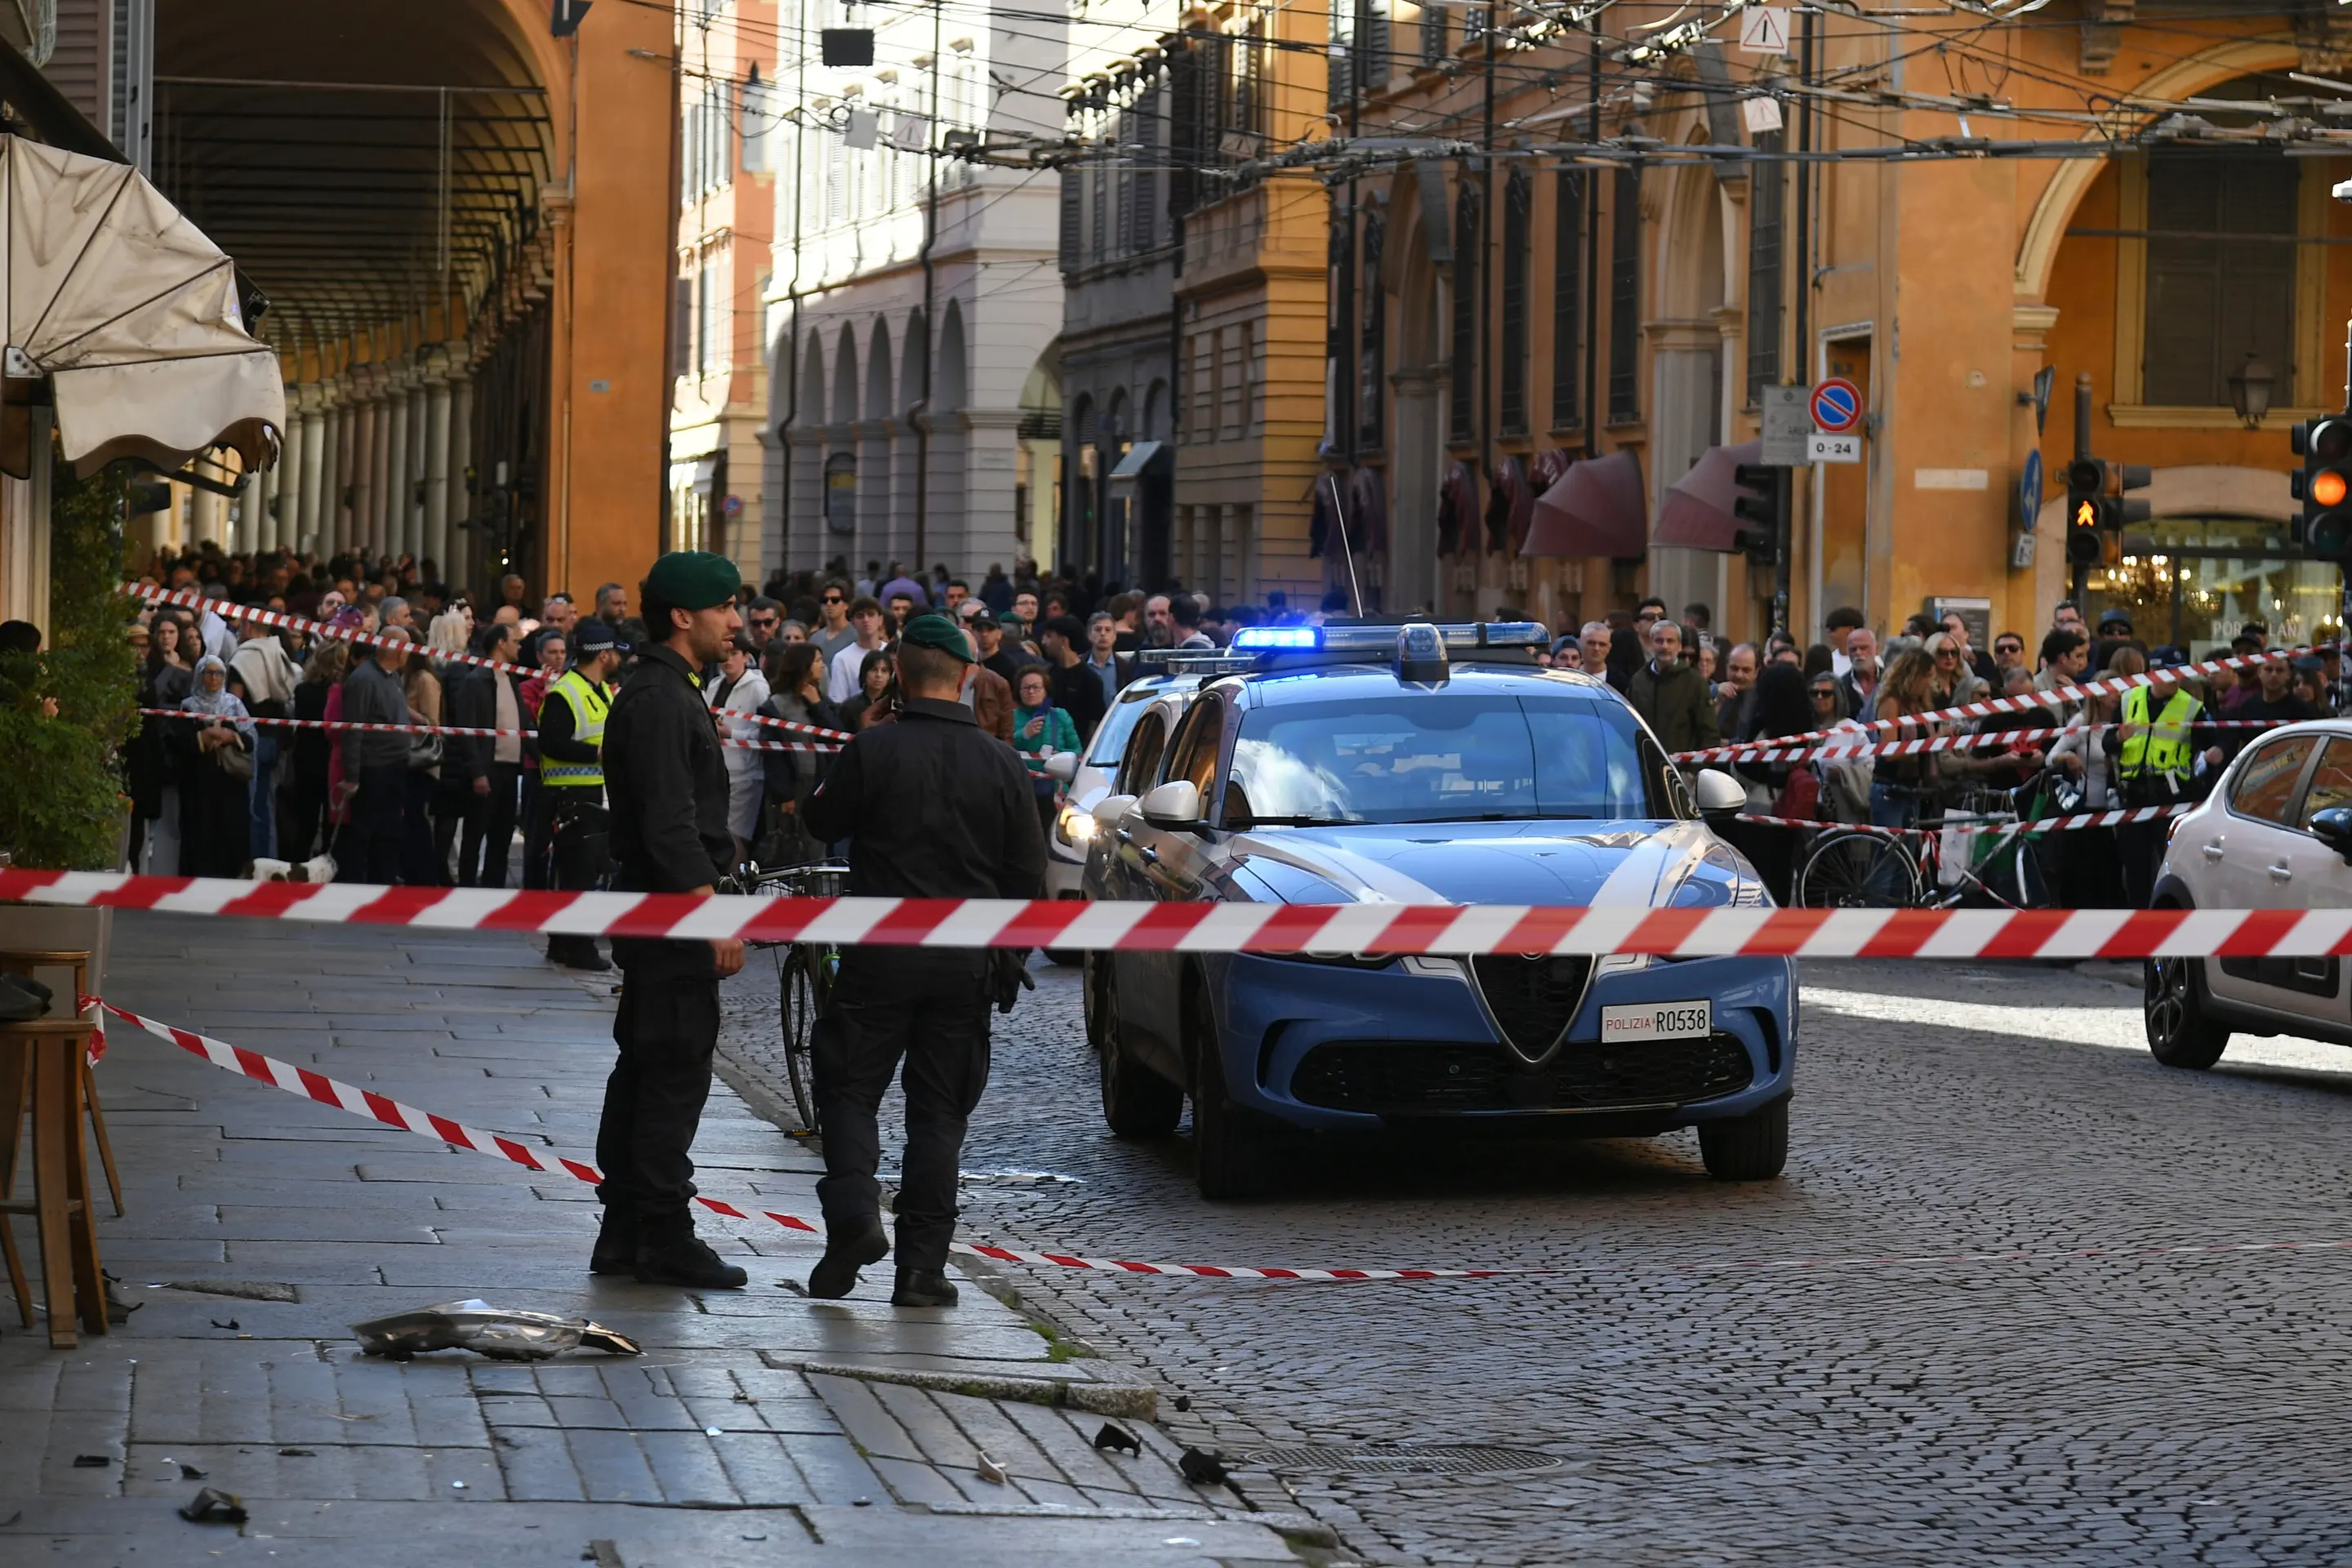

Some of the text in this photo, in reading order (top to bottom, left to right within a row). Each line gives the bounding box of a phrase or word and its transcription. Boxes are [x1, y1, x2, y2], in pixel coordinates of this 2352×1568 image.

[2213, 619, 2308, 638] PORLANA
[1606, 1009, 1706, 1032] POLIZIA R0538
